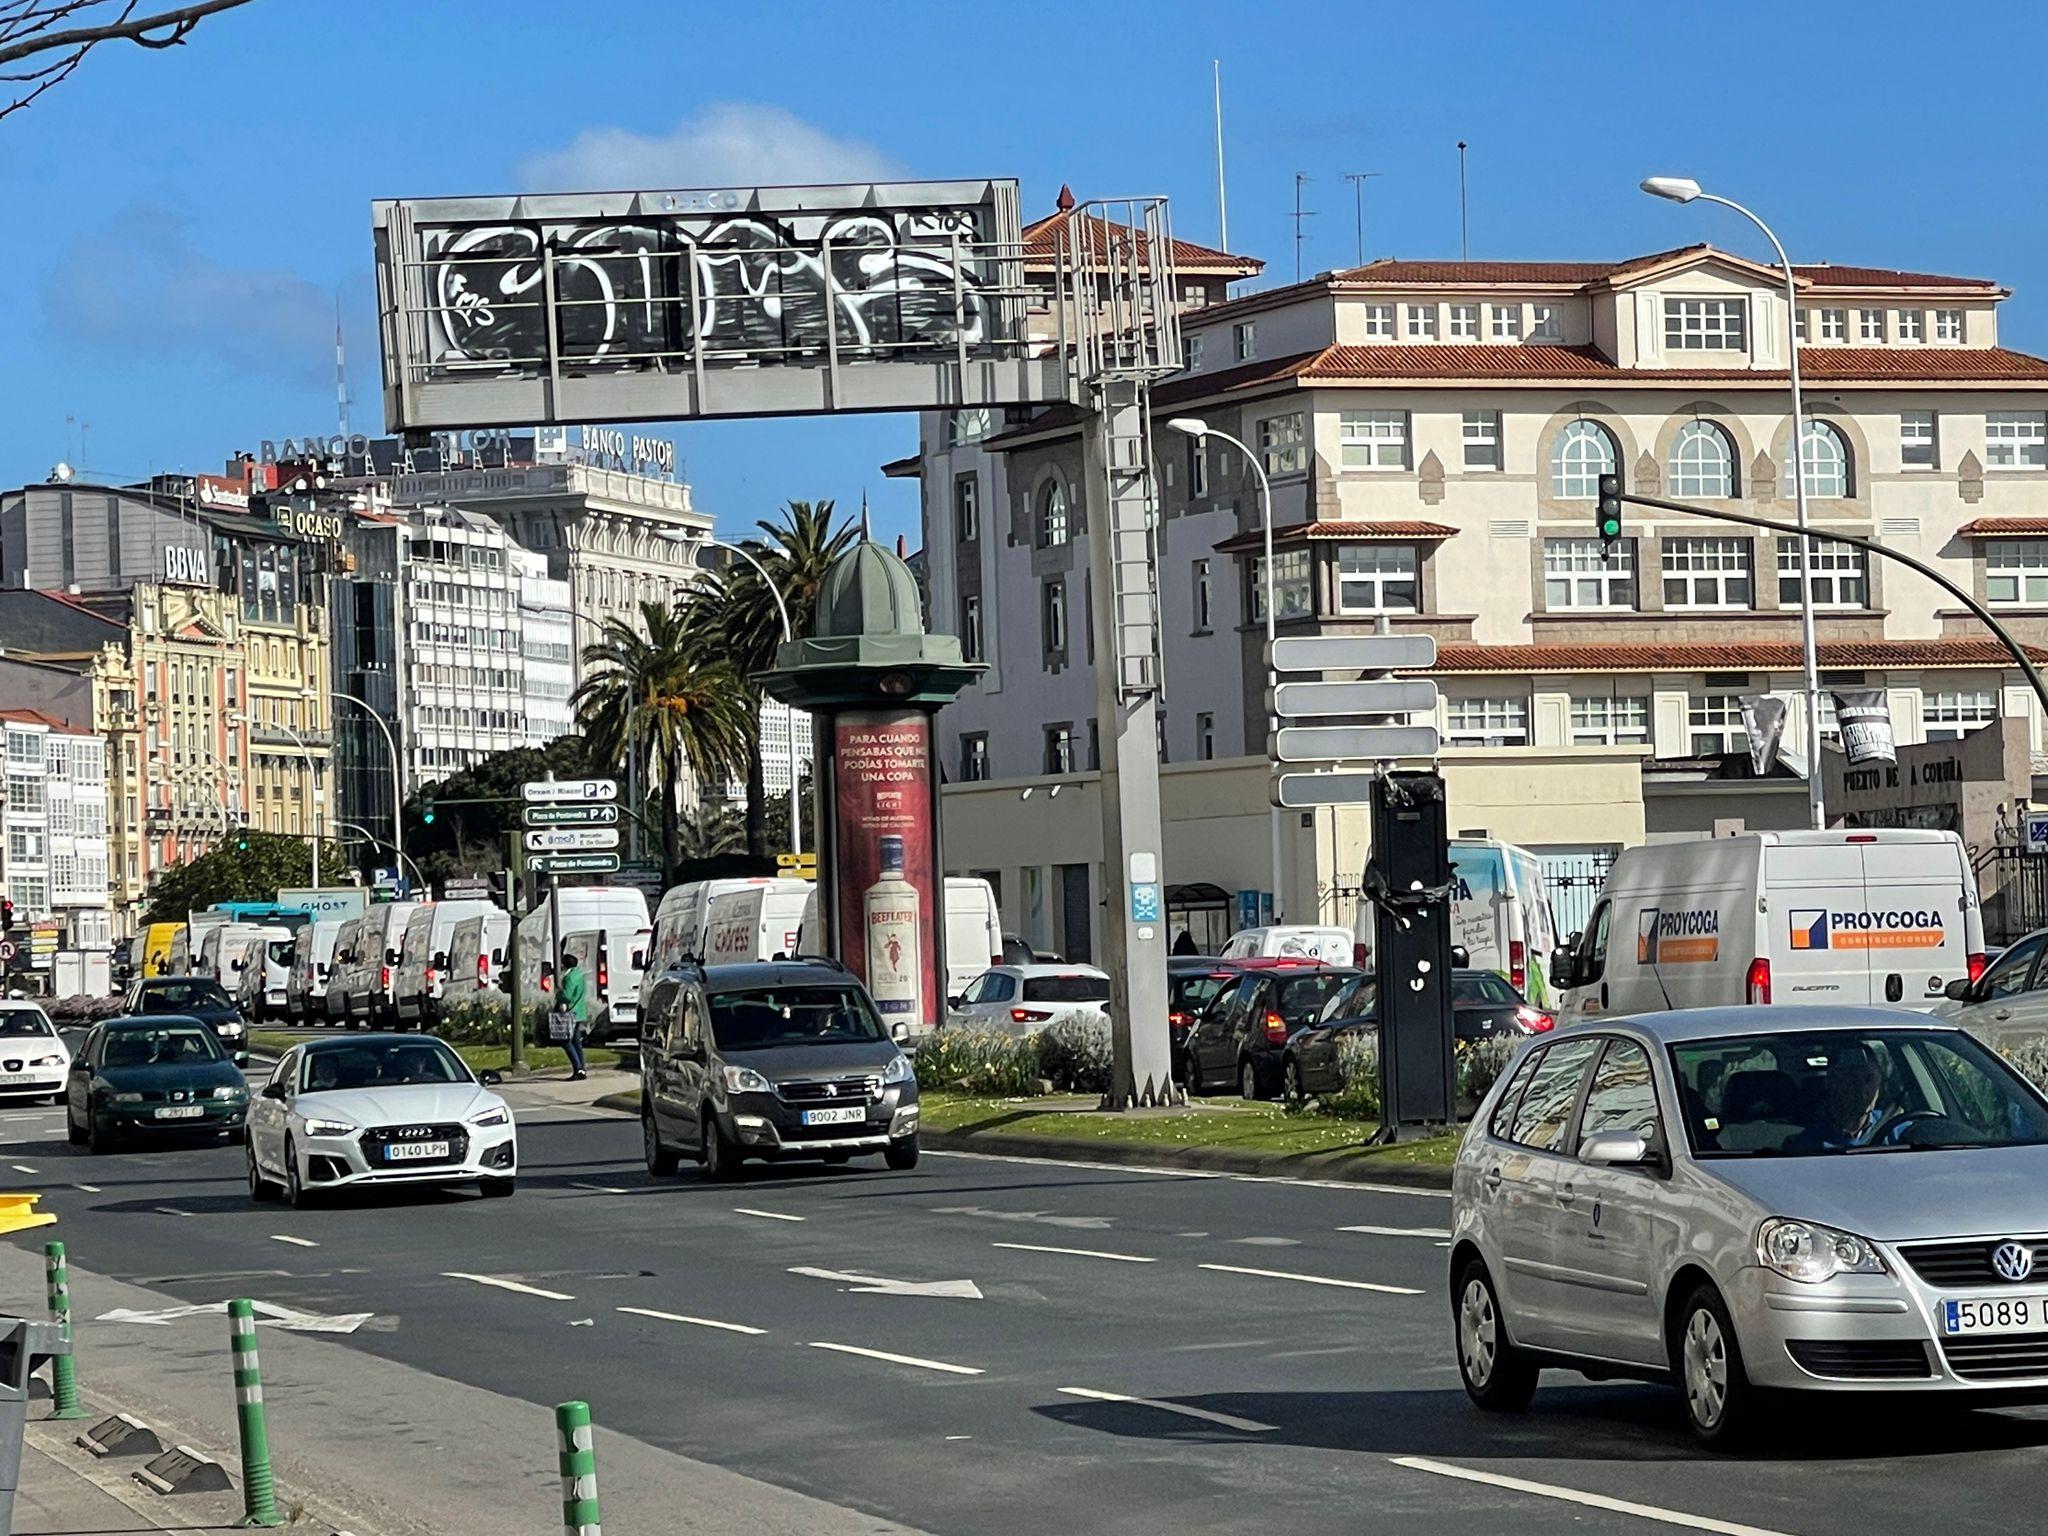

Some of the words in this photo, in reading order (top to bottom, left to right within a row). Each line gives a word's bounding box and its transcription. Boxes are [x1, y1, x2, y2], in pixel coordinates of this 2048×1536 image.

[261, 433, 369, 465] BANCO
[582, 424, 625, 457] BANCO
[632, 435, 673, 468] PASTOR
[296, 513, 341, 538] OCASO
[165, 545, 207, 583] BBVA
[849, 734, 877, 744] PARA
[879, 734, 919, 743] CUANDO
[840, 747, 893, 757] PENSABAS
[894, 746, 914, 757] QUE
[844, 757, 883, 769] PODÍAS
[884, 758, 925, 769] TOMARTE
[861, 772, 885, 781] UNA
[886, 771, 914, 781] COPA
[1843, 768, 1880, 792] PUERTO
[1886, 767, 1899, 788] DE
[1923, 756, 1963, 783] CORUÑA
[301, 901, 348, 910] GHOST
[871, 911, 914, 925] BEEFEATER
[1660, 910, 1718, 936] PROYCOGA
[1832, 911, 1943, 929] PROYCOGA
[809, 1110, 838, 1122] 9002
[842, 1109, 862, 1120] JNR
[392, 1145, 421, 1157] 0140
[425, 1143, 446, 1155] LPH
[1961, 1301, 2029, 1328] 5089
